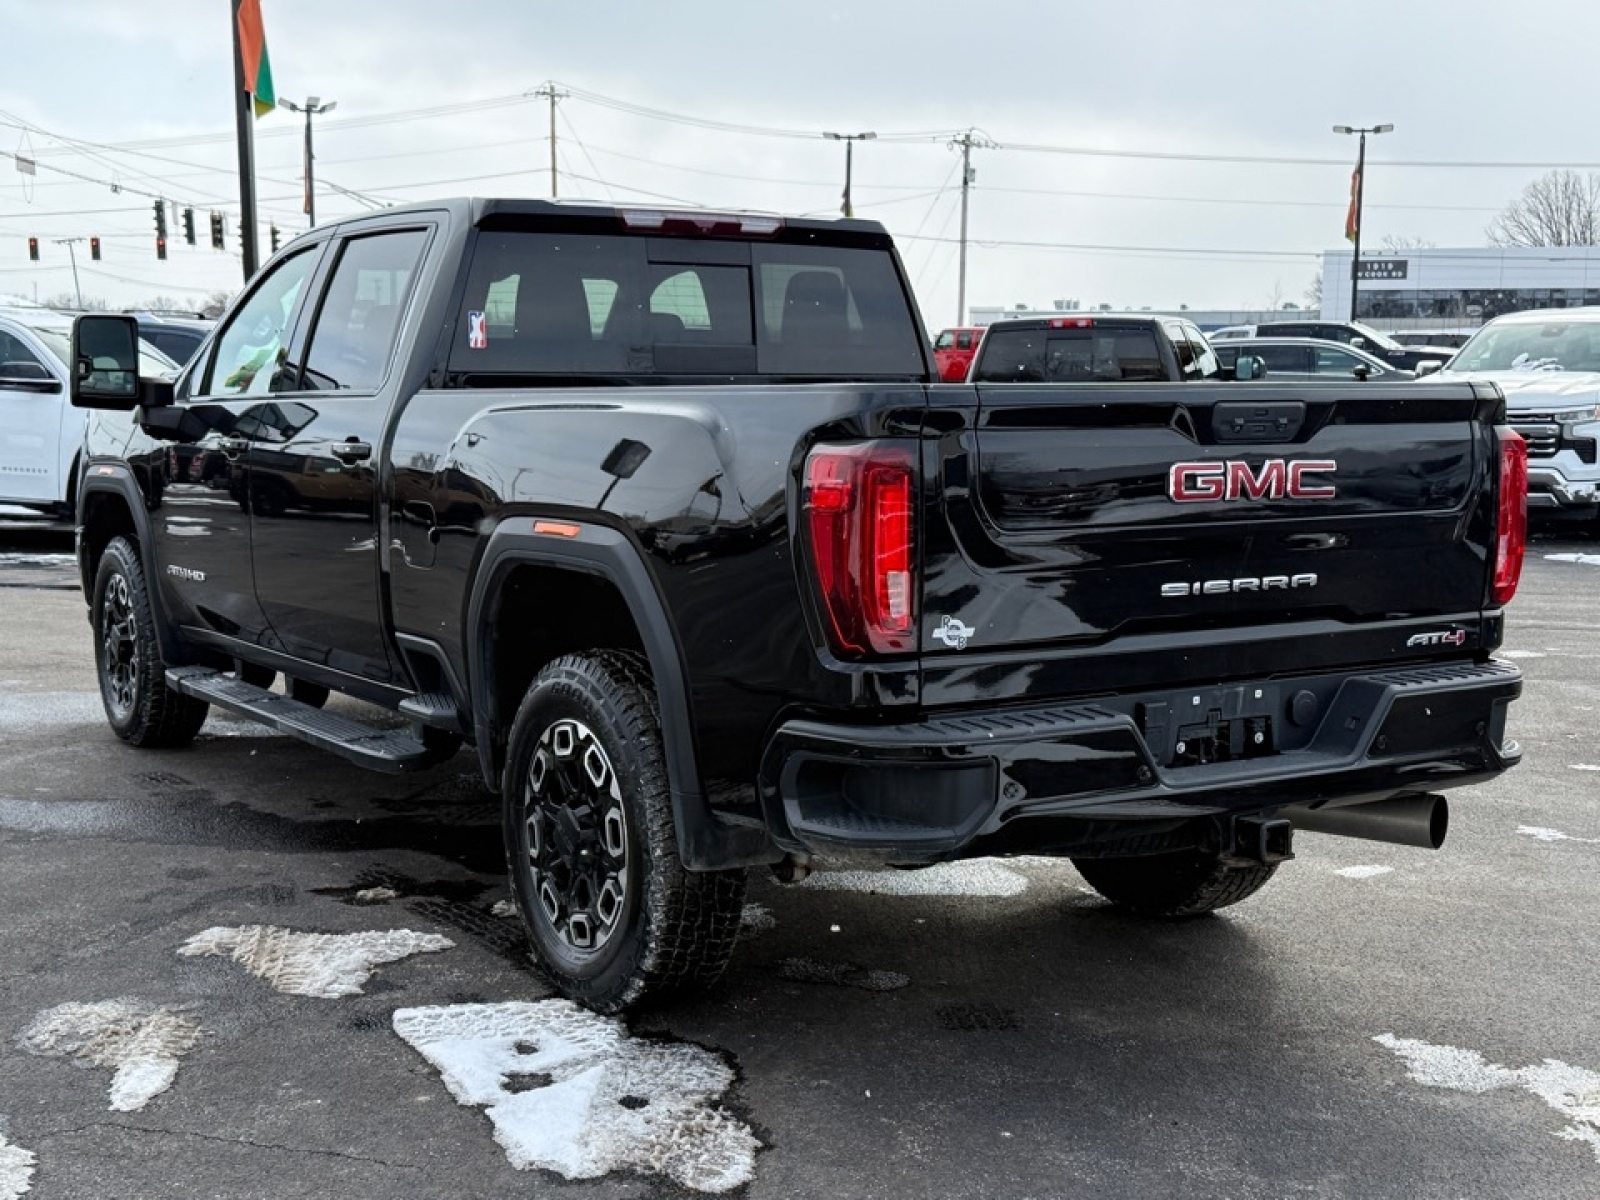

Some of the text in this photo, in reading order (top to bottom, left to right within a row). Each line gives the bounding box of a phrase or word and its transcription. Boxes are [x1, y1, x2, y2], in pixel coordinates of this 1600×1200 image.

[1169, 459, 1338, 502] GMC
[1160, 573, 1318, 597] SIERRA
[1406, 629, 1466, 648] AT4
